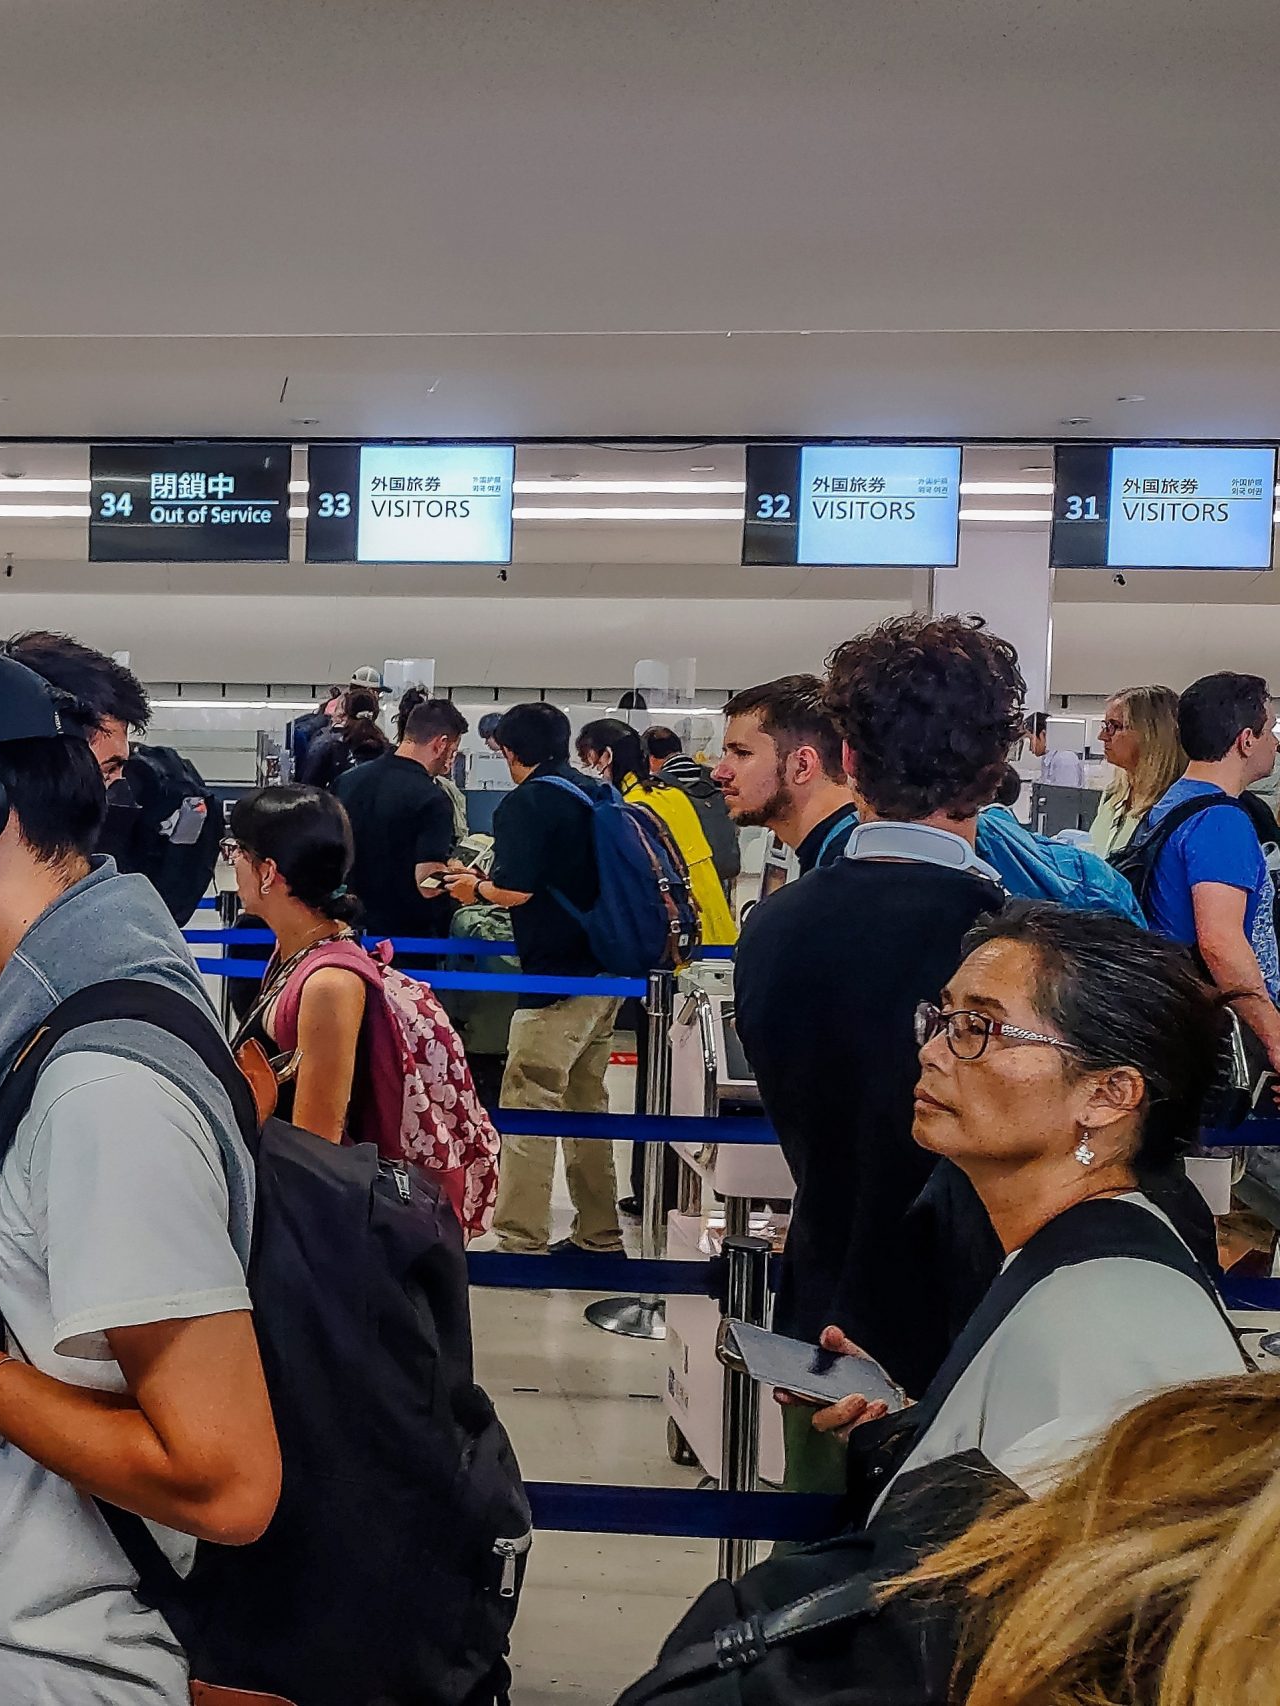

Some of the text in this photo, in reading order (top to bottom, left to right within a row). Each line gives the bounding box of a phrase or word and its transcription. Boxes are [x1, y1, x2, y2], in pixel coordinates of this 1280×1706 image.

[150, 472, 235, 500] 閉鎖中
[370, 475, 441, 492] 外国旅券
[812, 476, 886, 493] 外国旅券
[1122, 478, 1199, 495] 外国旅券
[100, 492, 133, 517] 34
[318, 492, 351, 518] 33
[370, 499, 470, 518] VISITORS
[756, 494, 791, 519] 32
[812, 500, 916, 521] VISITORS
[1066, 495, 1100, 520] 31
[1122, 502, 1229, 522] VISITORS
[150, 505, 272, 525] Out of Service
